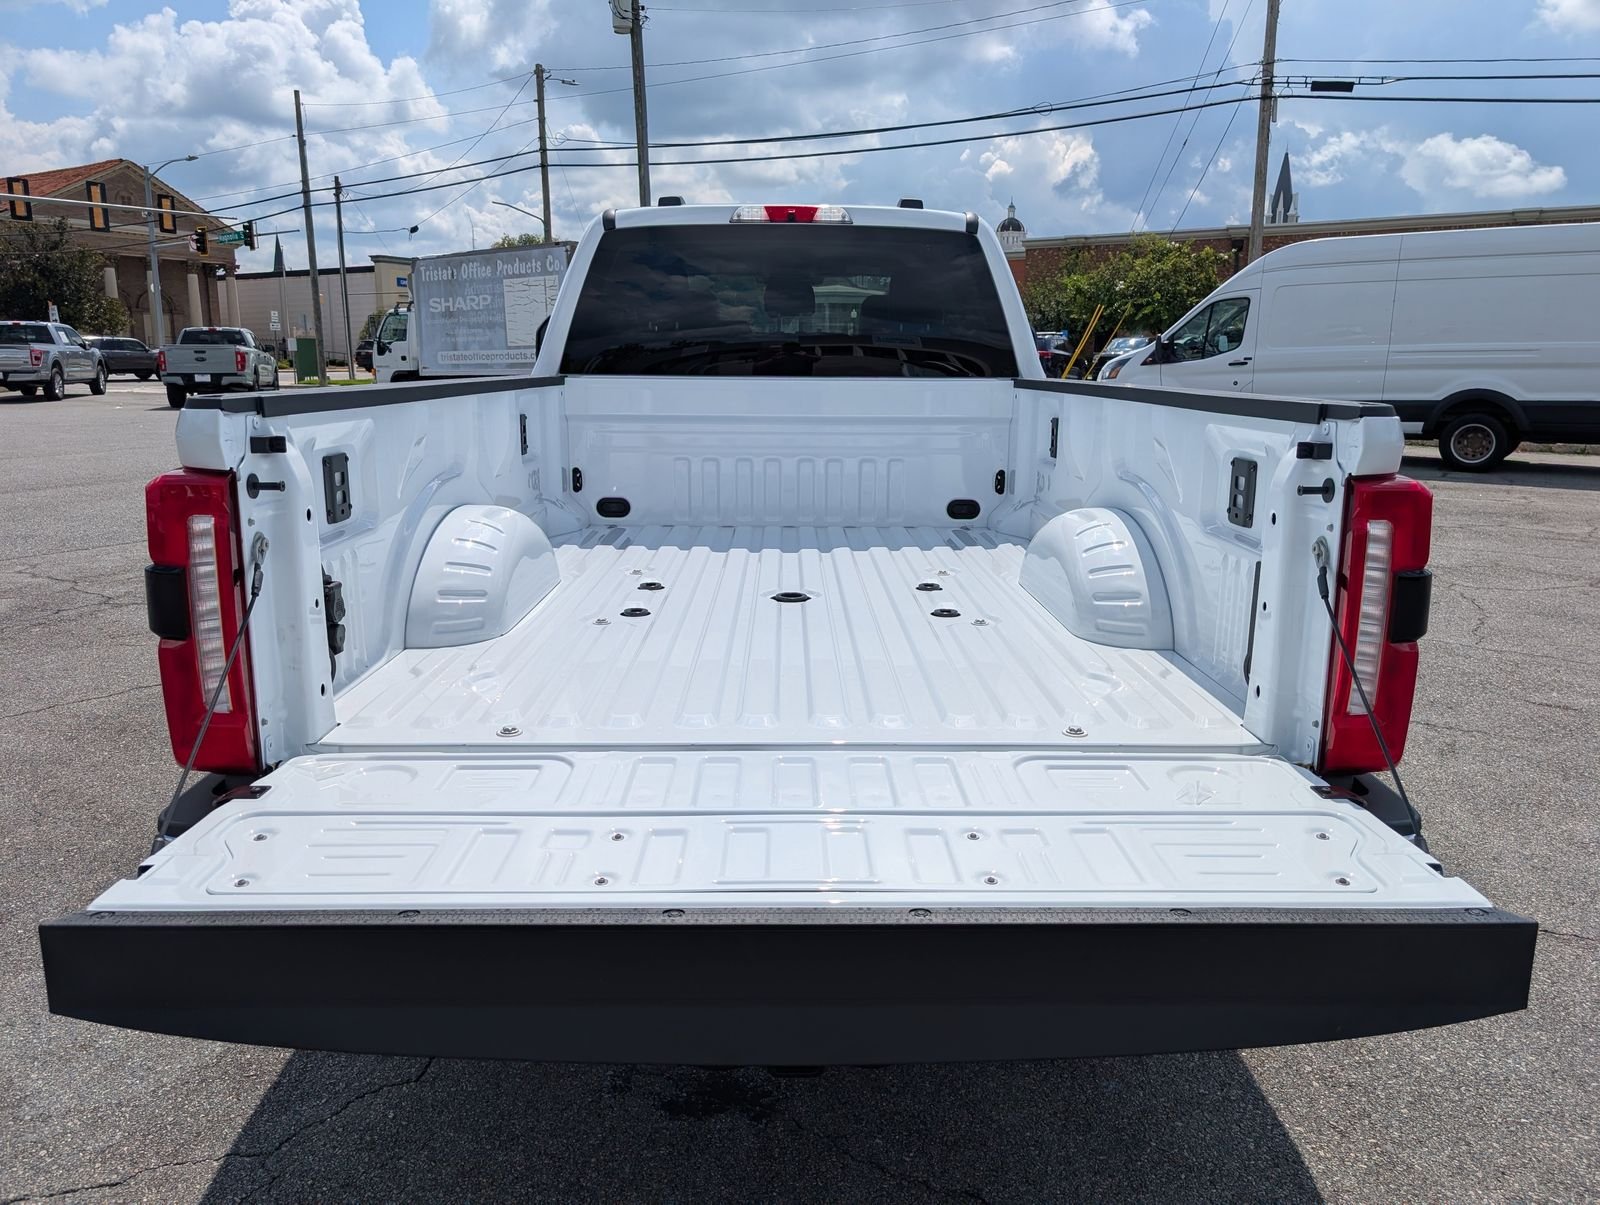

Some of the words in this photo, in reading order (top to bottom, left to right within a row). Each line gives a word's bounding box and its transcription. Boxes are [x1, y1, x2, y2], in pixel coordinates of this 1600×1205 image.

[420, 266, 457, 281] Tristate
[461, 262, 492, 280] Office
[496, 256, 542, 276] Products
[546, 254, 564, 272] Co.
[429, 294, 492, 313] SHARP
